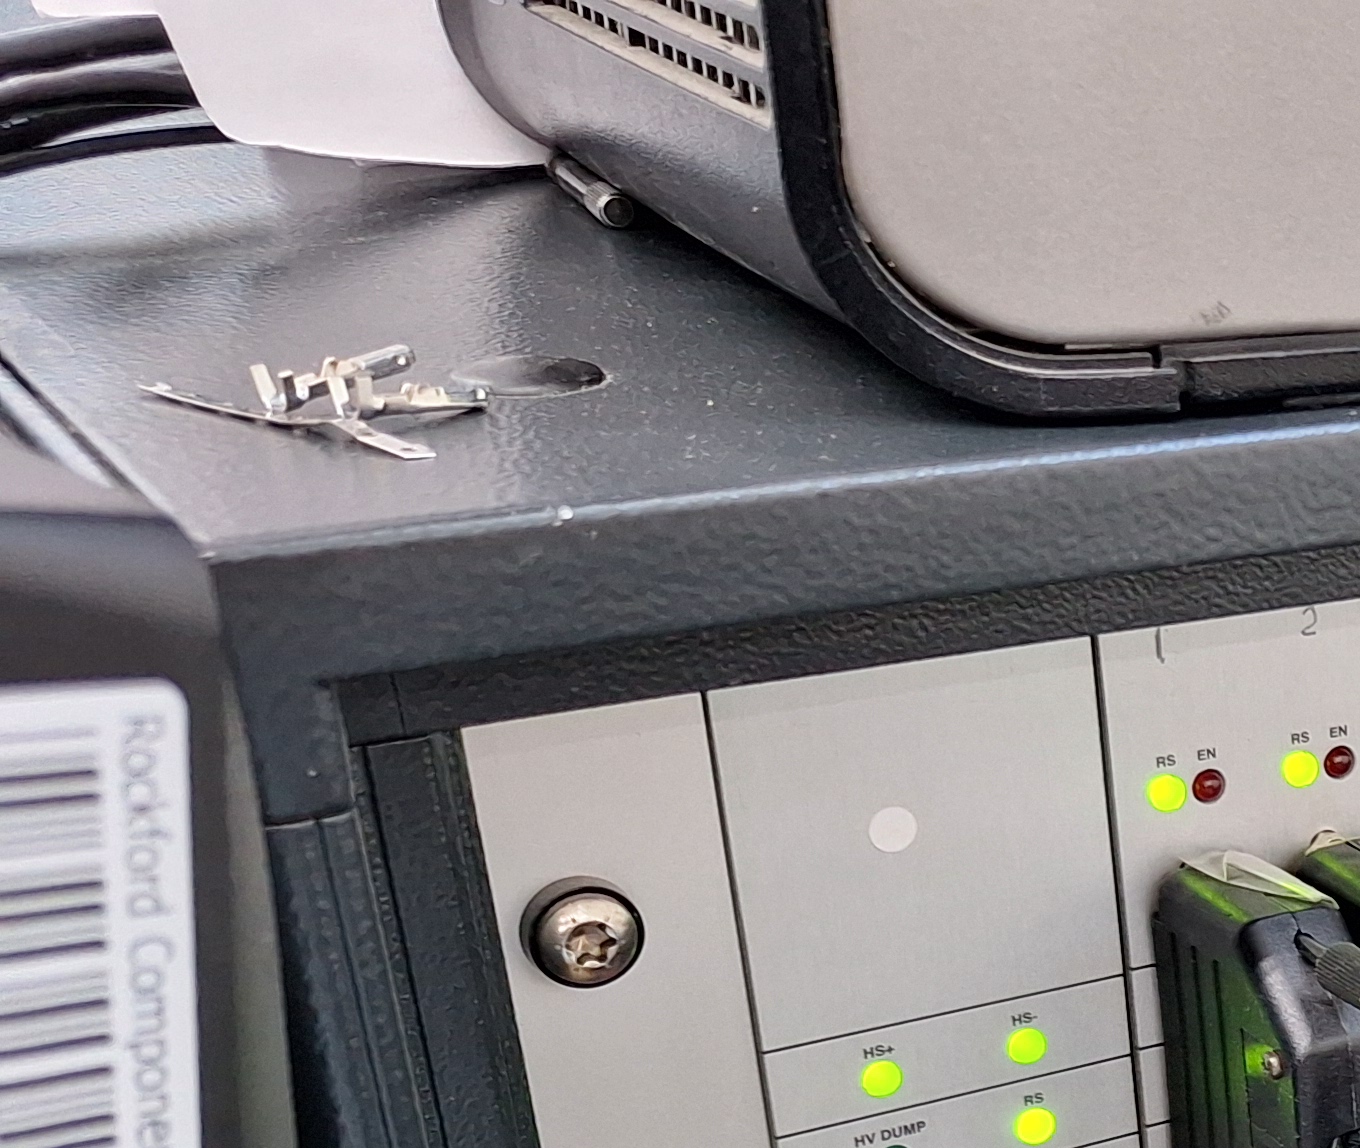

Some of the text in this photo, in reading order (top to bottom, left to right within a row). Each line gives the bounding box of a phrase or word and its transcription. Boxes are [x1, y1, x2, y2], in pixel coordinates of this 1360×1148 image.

[1300, 605, 1318, 637] 2
[1290, 724, 1349, 746] RS EN
[1155, 747, 1218, 769] RS EN
[122, 713, 172, 919] Rockford
[862, 1043, 896, 1061] HS+
[1023, 1091, 1045, 1107] RS
[853, 1119, 928, 1148] HV DUMP
